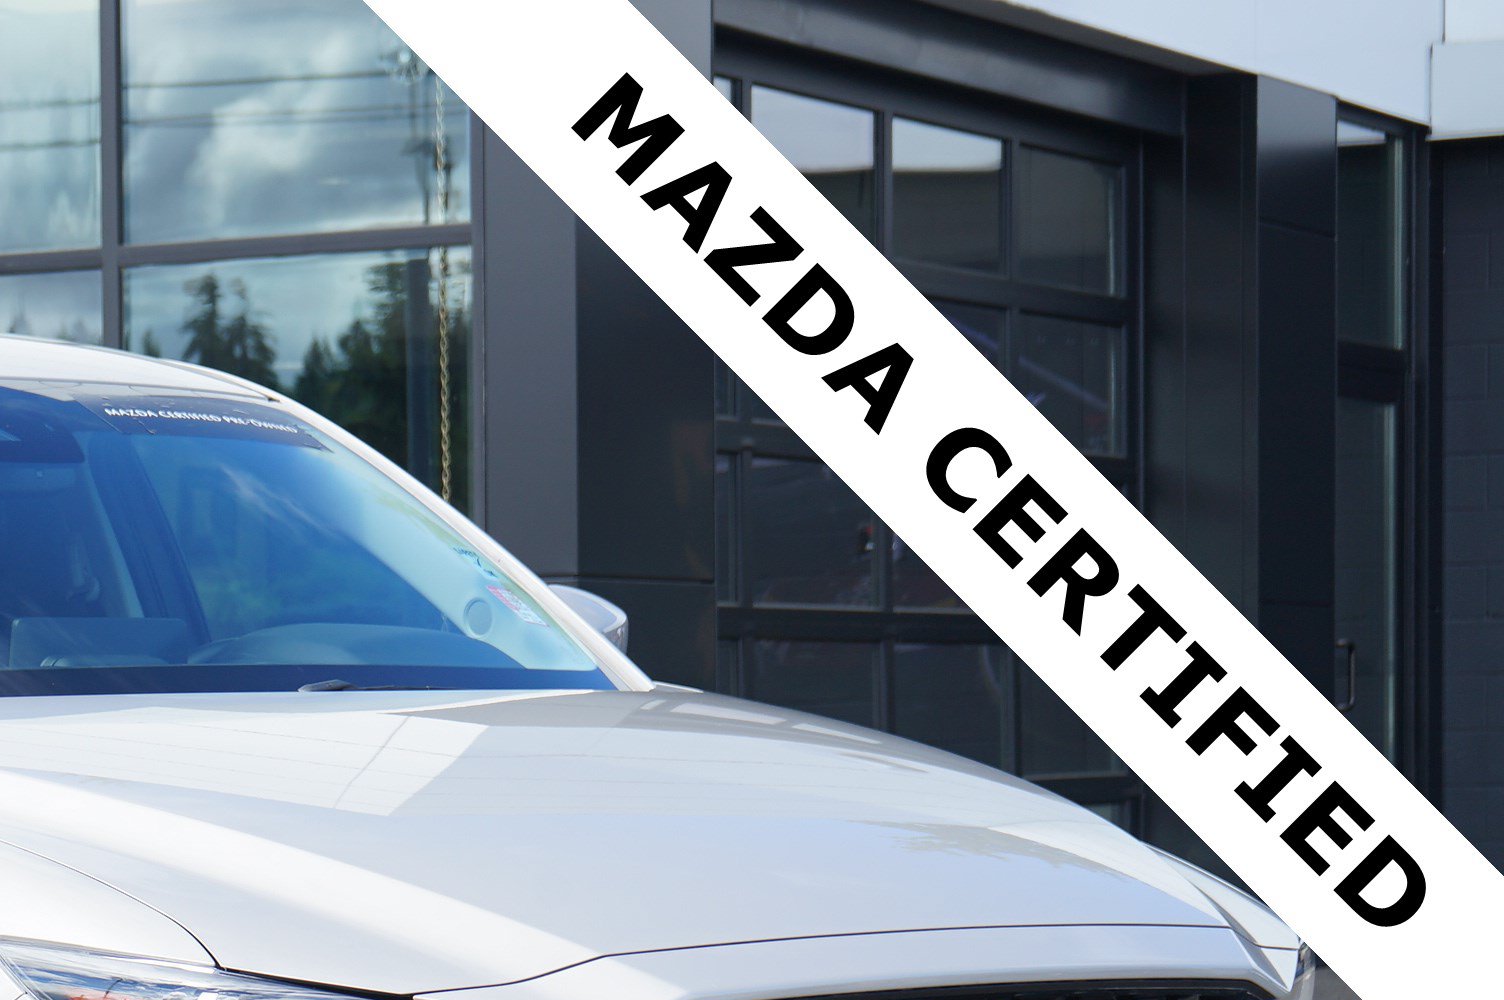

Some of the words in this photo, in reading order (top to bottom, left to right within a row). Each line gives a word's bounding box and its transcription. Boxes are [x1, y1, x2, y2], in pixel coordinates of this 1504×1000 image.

[104, 408, 158, 418] MAZDA
[158, 410, 222, 422] CERTIFIED
[222, 415, 298, 434] PRE-OWNED
